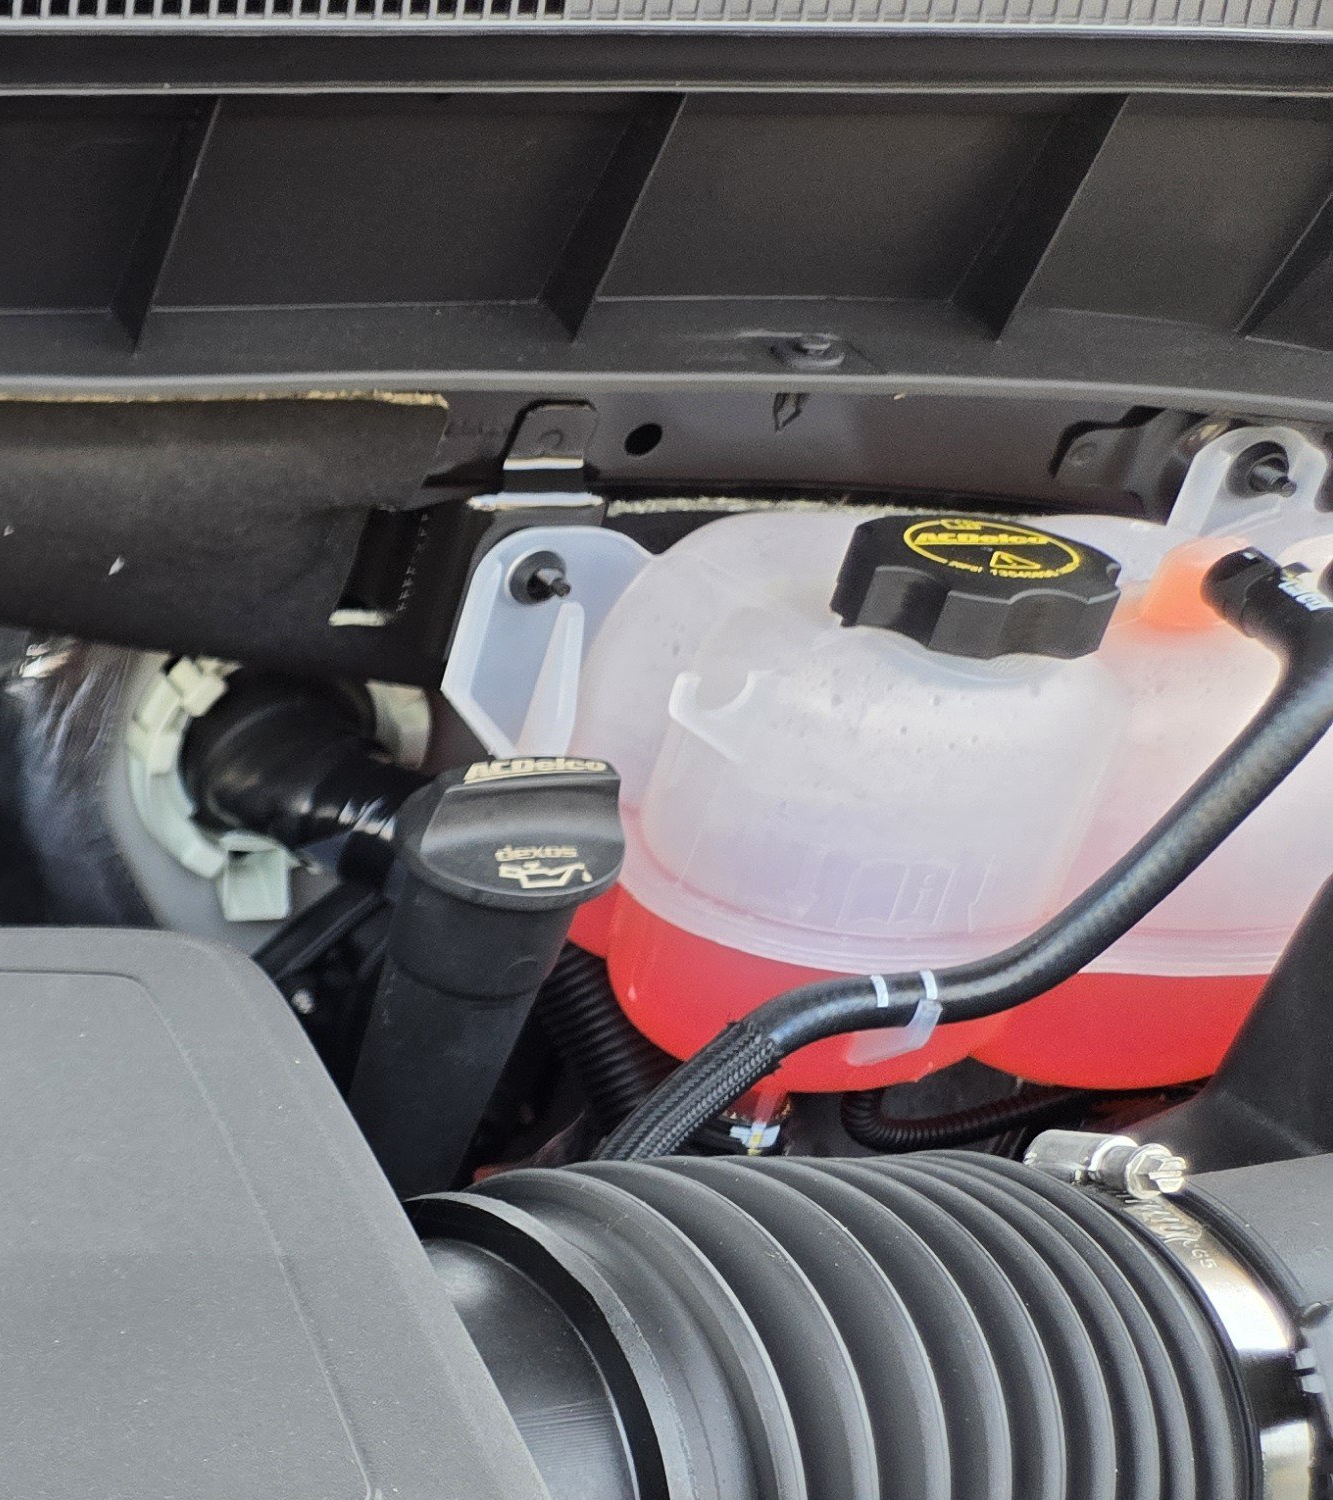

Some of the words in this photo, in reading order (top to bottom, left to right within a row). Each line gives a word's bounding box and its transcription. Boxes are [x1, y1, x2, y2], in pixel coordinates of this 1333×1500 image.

[914, 532, 1050, 546] ACDelco
[463, 757, 608, 784] ACDelco
[494, 844, 578, 862] dexos
